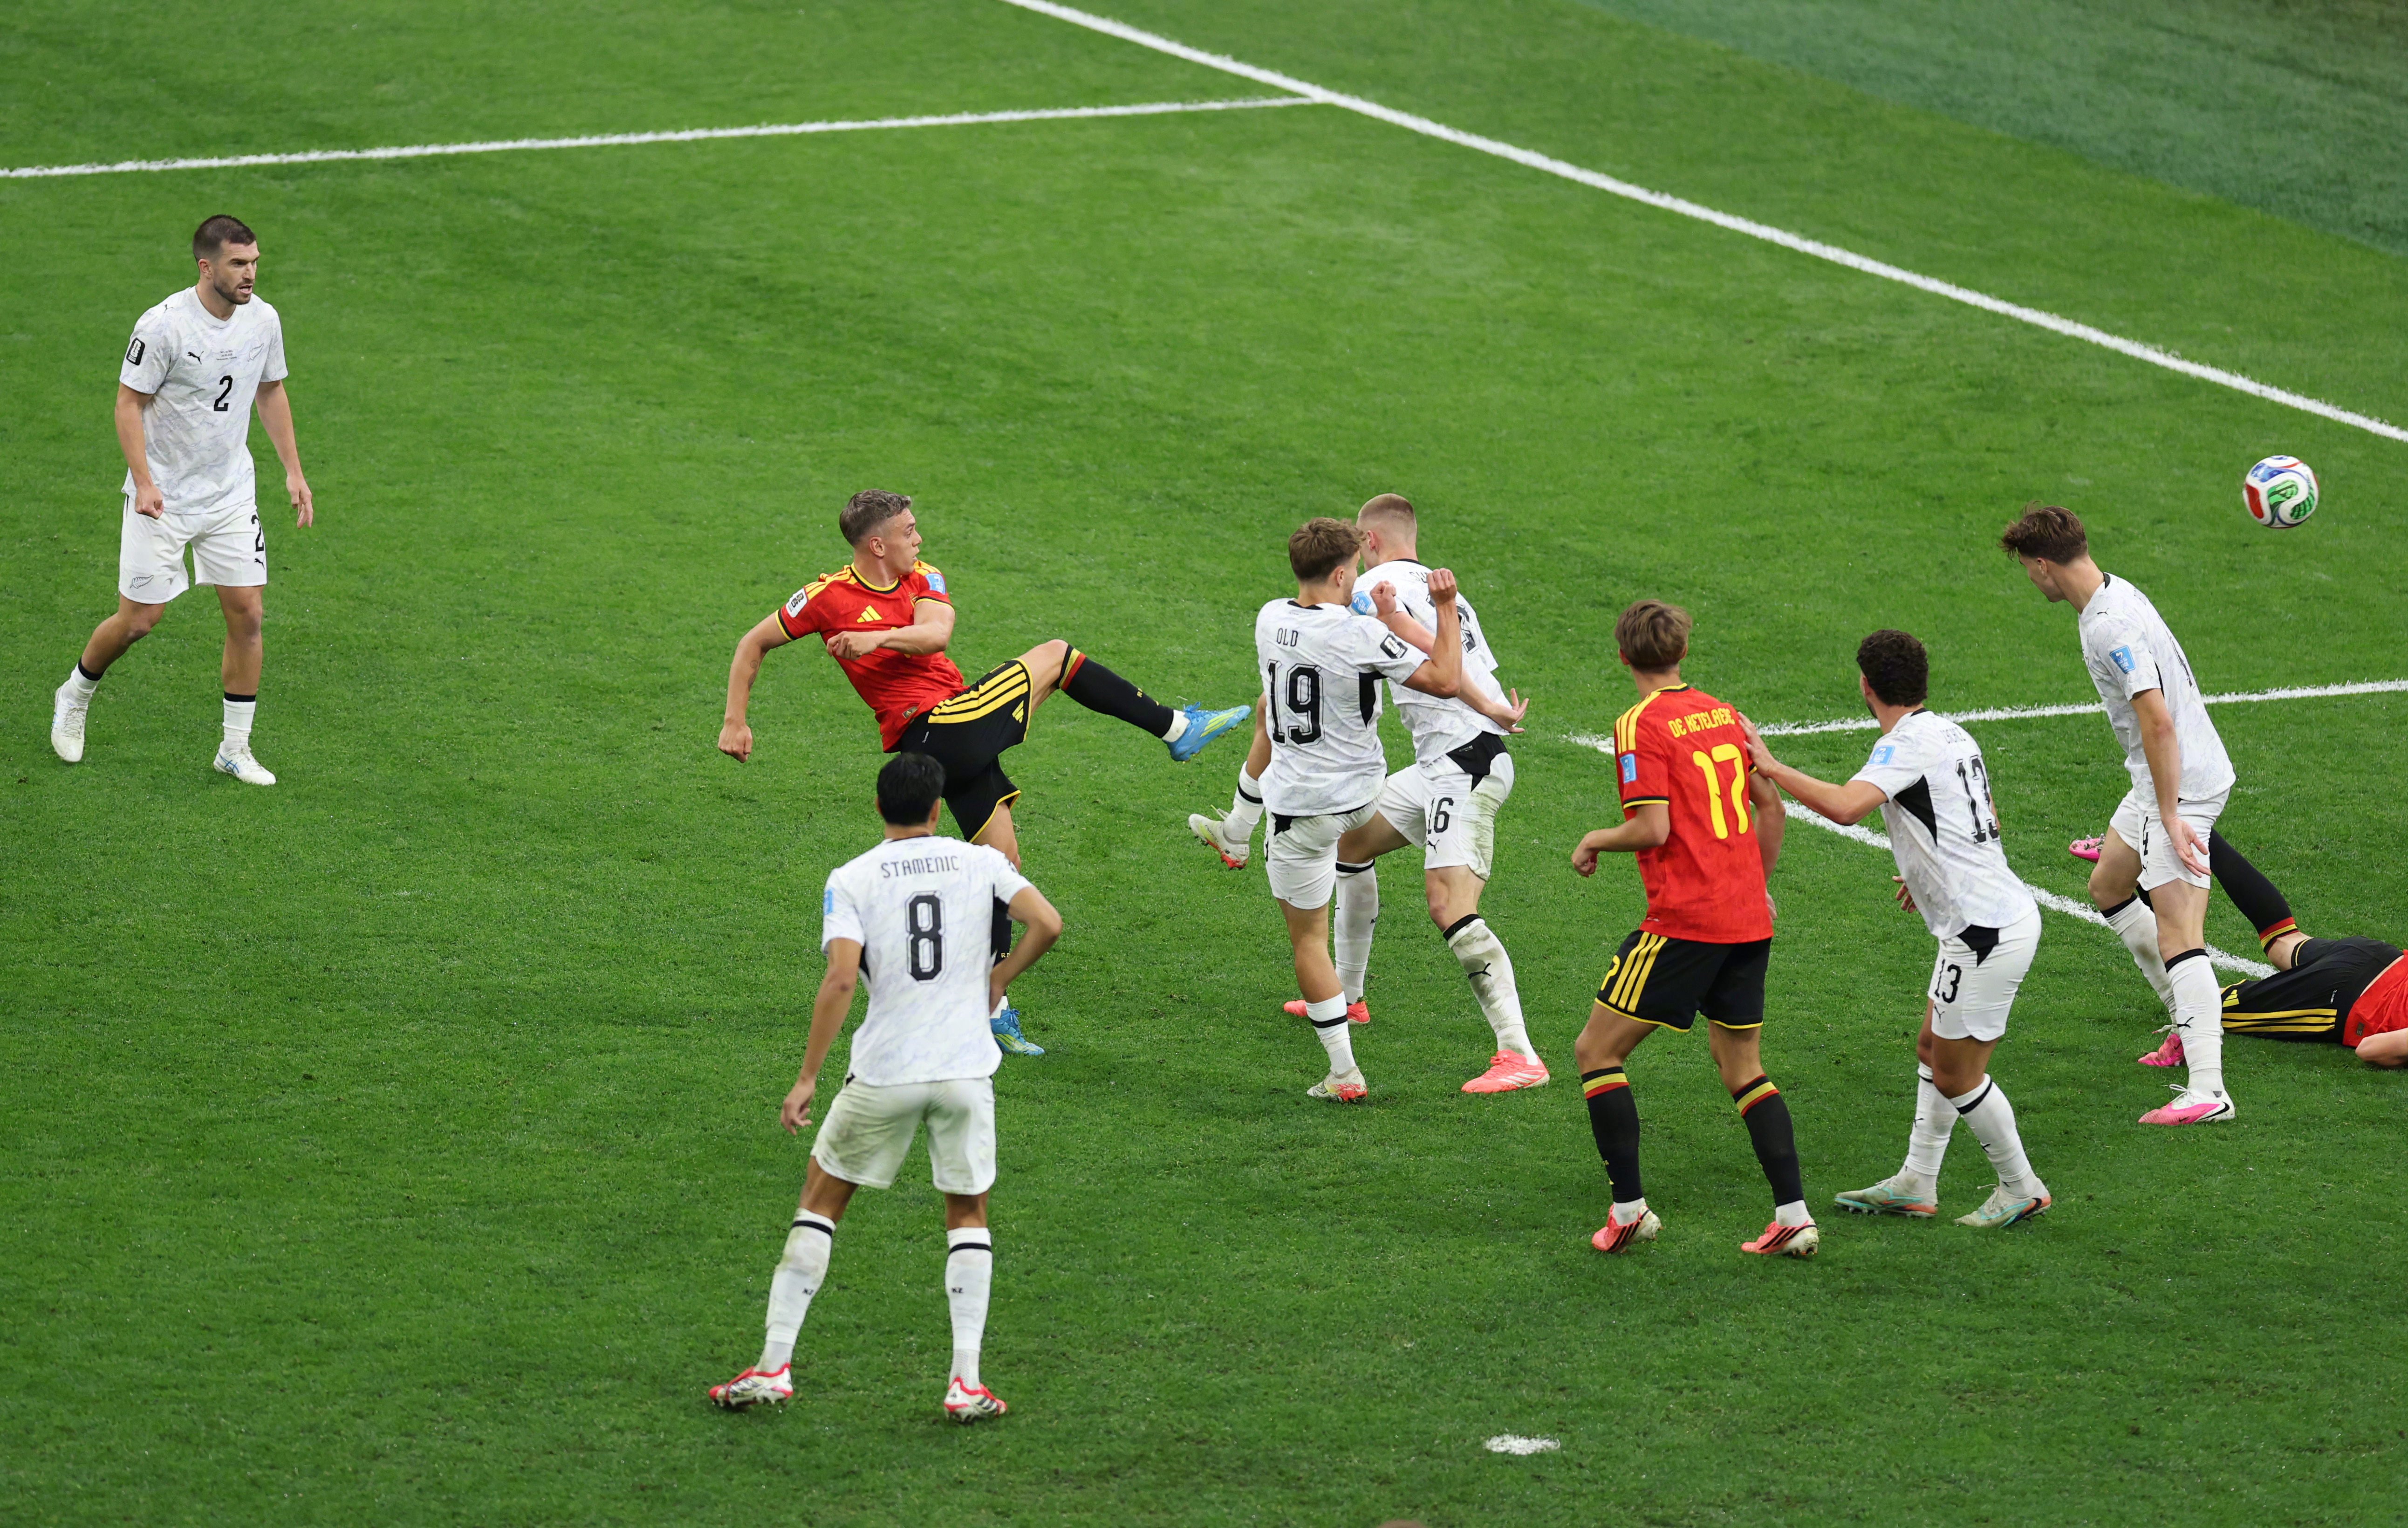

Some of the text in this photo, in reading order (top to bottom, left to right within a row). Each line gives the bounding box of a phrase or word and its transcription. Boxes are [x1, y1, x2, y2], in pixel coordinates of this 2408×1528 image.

[214, 375, 233, 411] 2
[251, 514, 264, 552] 2
[1276, 628, 1299, 647] OLD
[1266, 659, 1326, 747] 19
[1667, 718, 1687, 738] DE
[1692, 743, 1749, 840] 17
[1956, 754, 2000, 845] 13
[1427, 797, 1454, 835] 16
[881, 855, 960, 878] STAMENIC
[905, 890, 947, 985] 8
[1934, 958, 1963, 1004] 13
